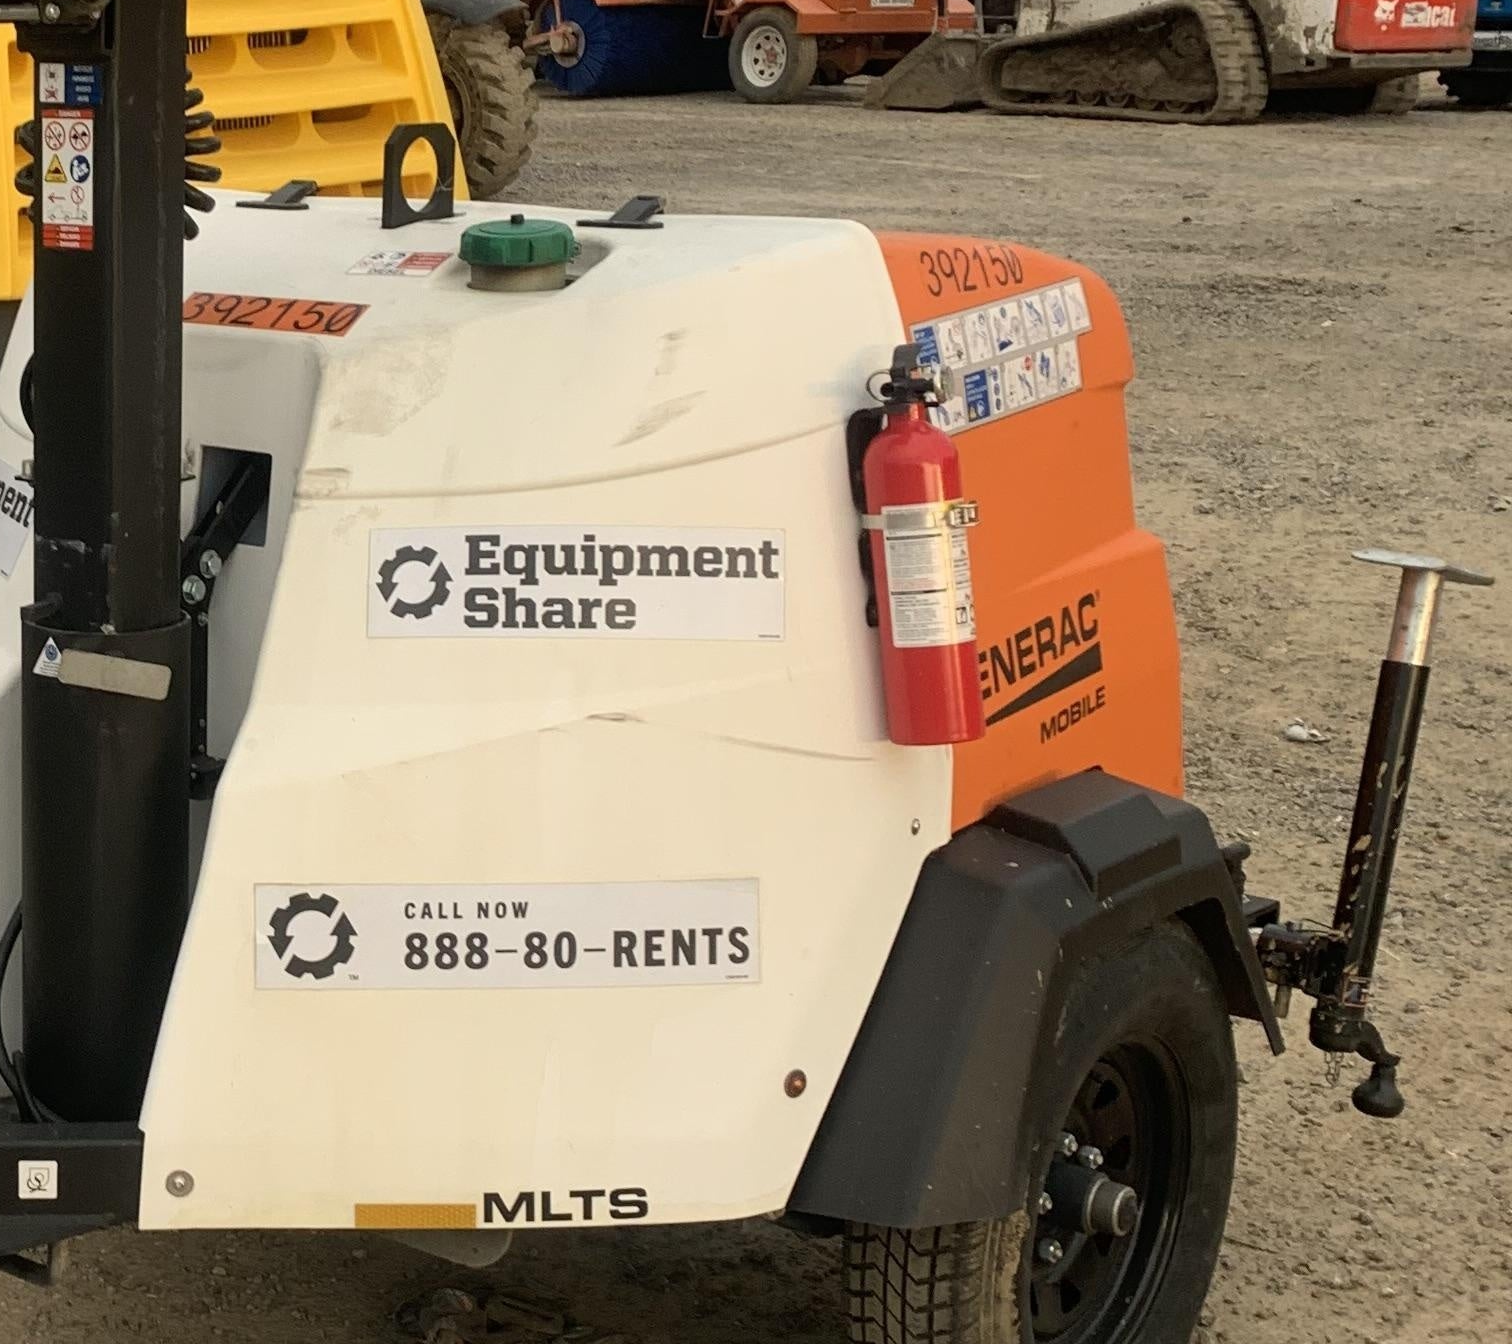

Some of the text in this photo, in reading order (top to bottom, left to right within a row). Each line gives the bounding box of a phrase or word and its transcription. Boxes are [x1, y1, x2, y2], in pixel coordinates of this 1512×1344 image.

[919, 244, 1024, 297] 392150
[183, 292, 364, 333] 392150
[464, 534, 779, 586] Equipment
[463, 587, 637, 630] Share
[1039, 686, 1106, 744] MOBILE
[404, 901, 530, 920] CALL NOW
[403, 926, 750, 971] 888-80-RENTS
[483, 1187, 649, 1224] MLTS
